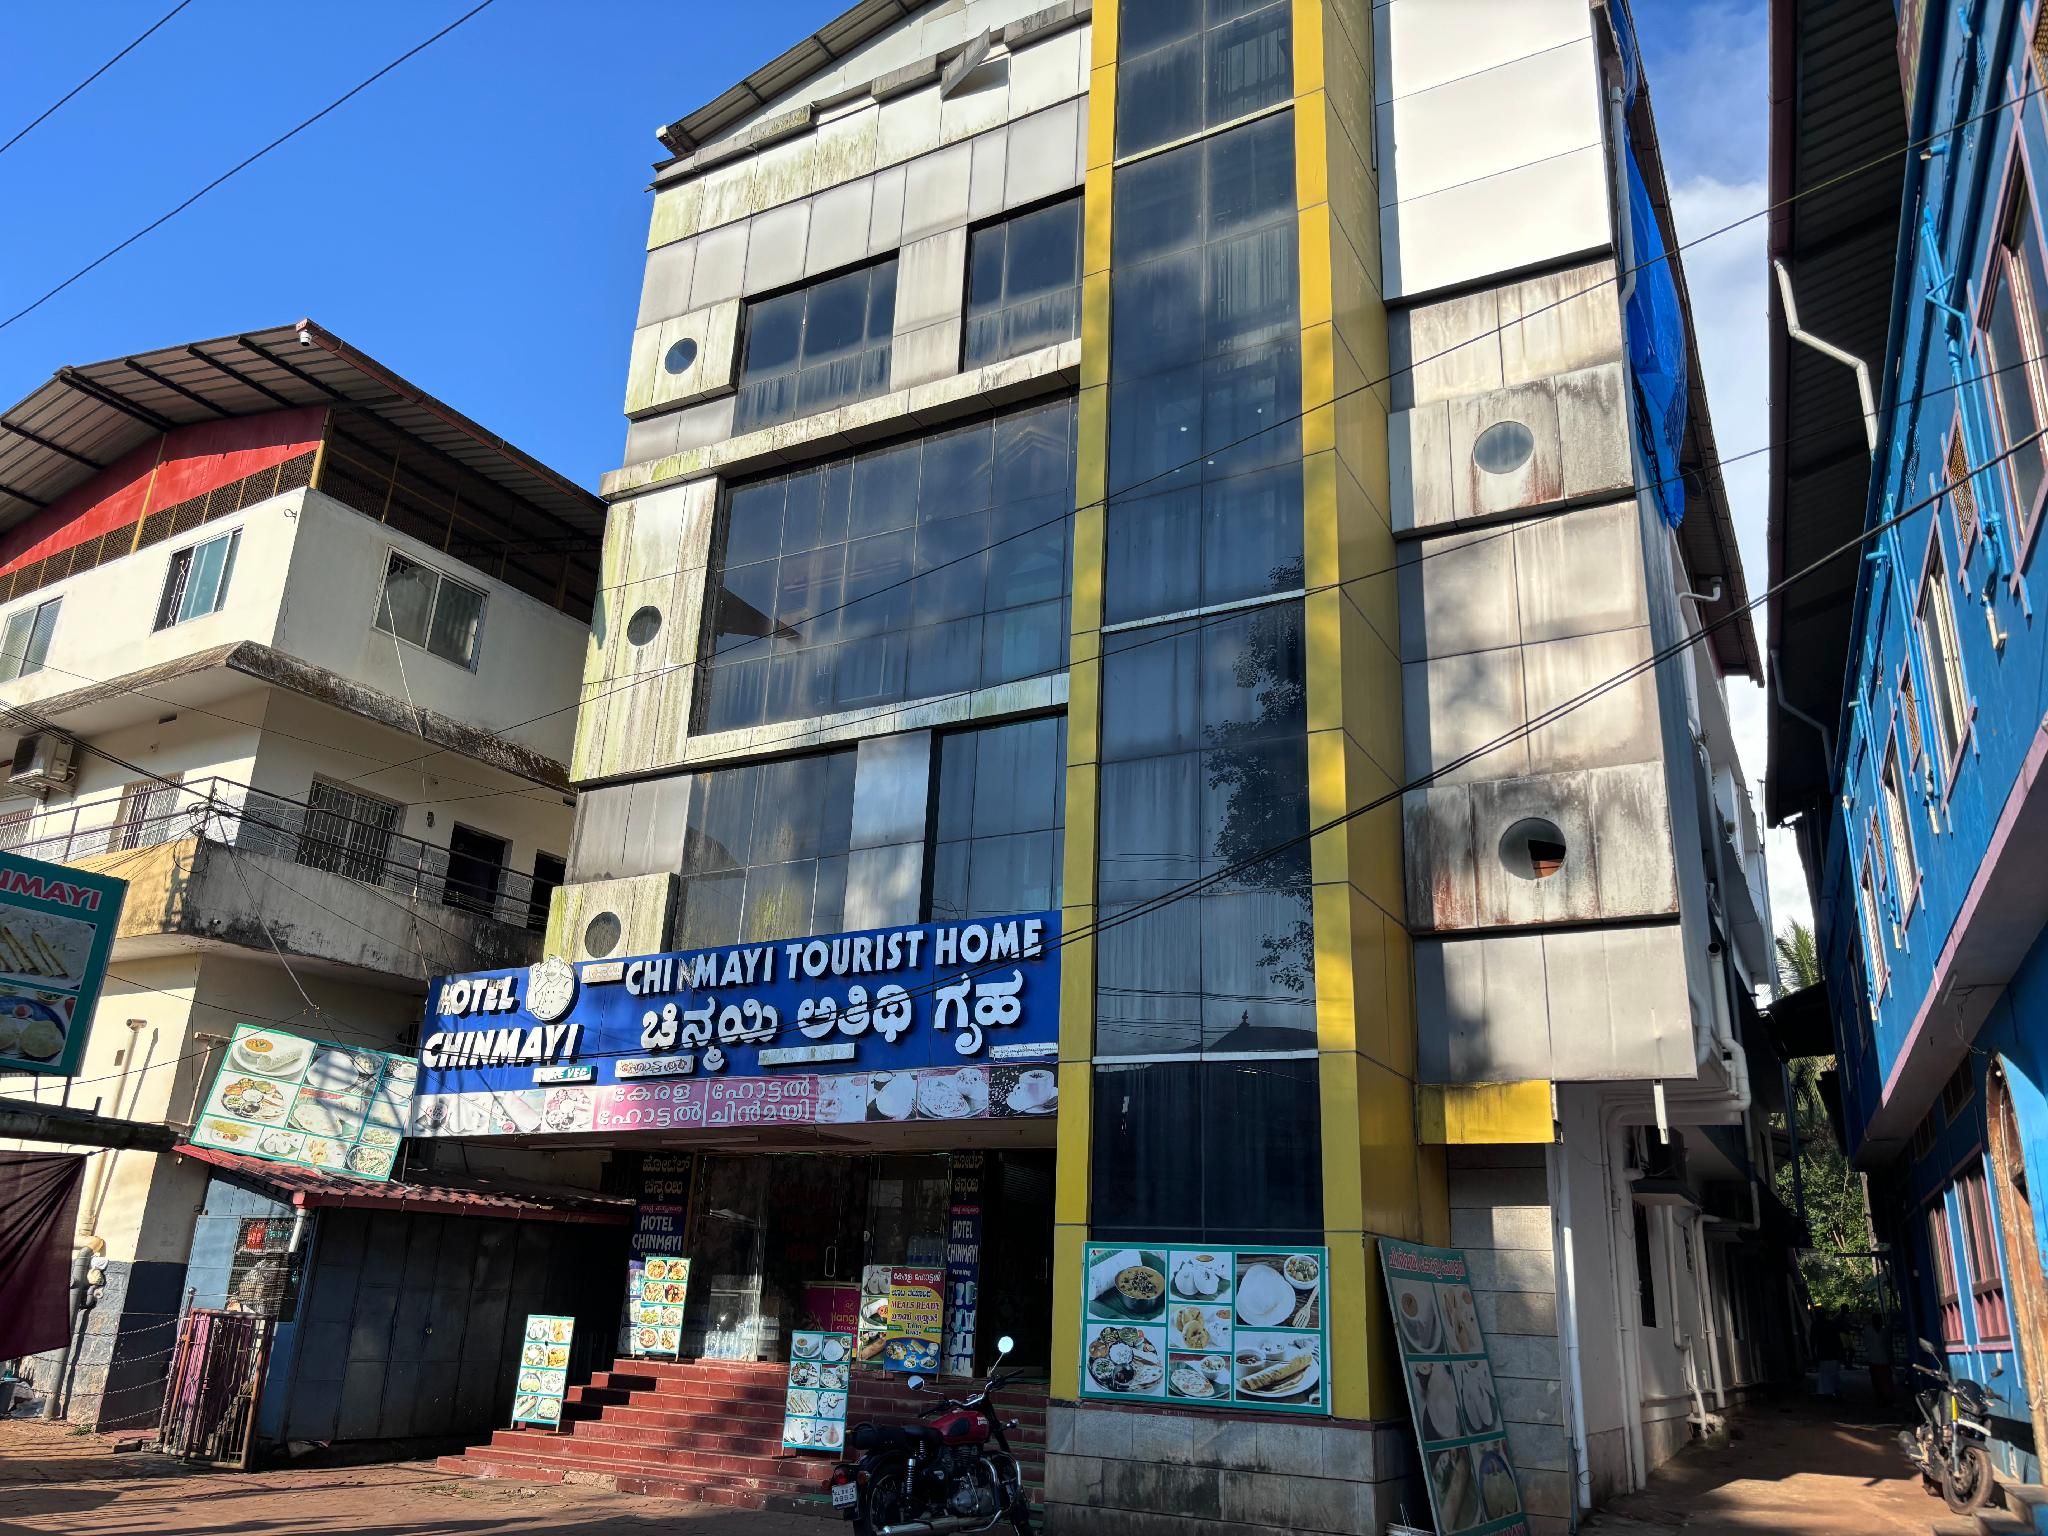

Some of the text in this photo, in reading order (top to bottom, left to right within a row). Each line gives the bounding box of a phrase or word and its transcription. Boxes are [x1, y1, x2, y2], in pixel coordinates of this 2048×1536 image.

[625, 919, 1043, 995] CHINMAYI TOURIST HOME
[436, 976, 516, 1016] HOTEL
[641, 969, 1024, 1071] ಚಿನ್ಮಯಿ ಅತಿಥಿ ಗೃಹ
[422, 1024, 579, 1067] CHINMAYI
[614, 1083, 692, 1104] കേരള
[711, 1078, 810, 1102] ഹോട്ടൽ
[597, 1101, 702, 1126] ഹോട്ടൽ
[640, 1215, 674, 1231] HOTEL
[952, 1220, 973, 1239] HOTEL
[632, 1233, 683, 1251] CHINMAYI
[947, 1243, 979, 1265] CHINMAYI
[891, 1301, 940, 1310] MEALS READY
